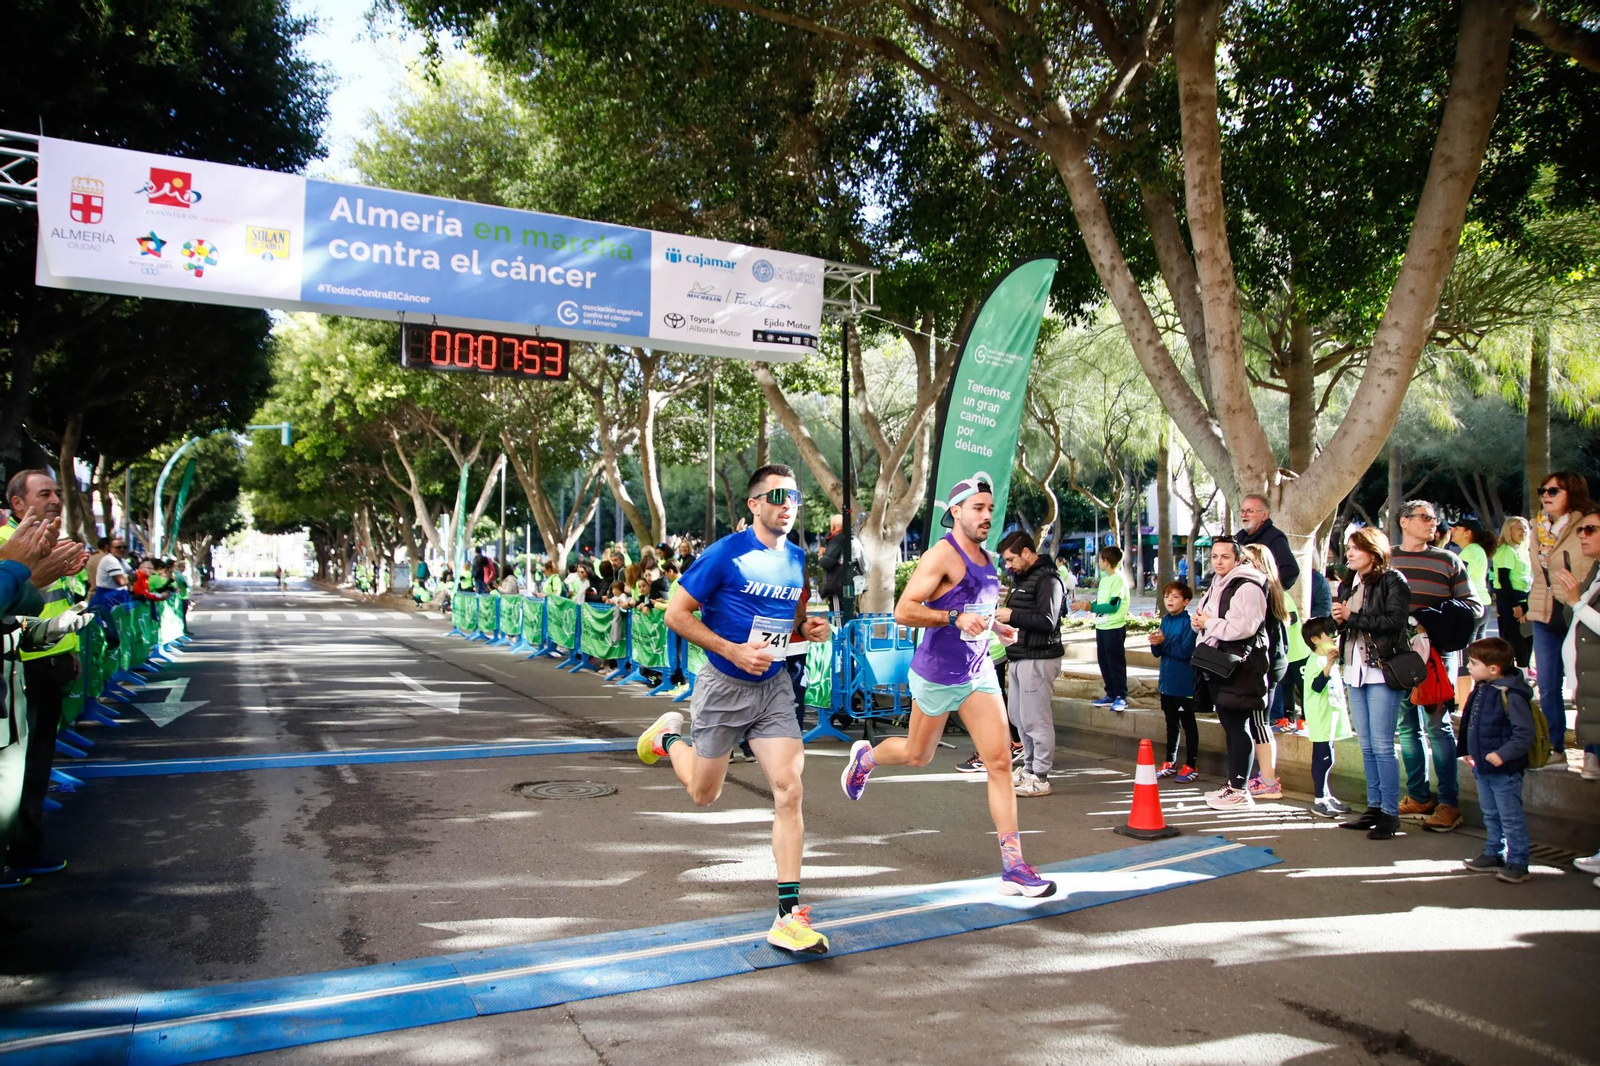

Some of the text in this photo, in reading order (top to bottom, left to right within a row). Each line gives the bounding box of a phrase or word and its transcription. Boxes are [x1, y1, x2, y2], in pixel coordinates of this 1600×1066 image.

[50, 227, 116, 244] ALMERÍA
[251, 229, 285, 244] SOLAN
[329, 196, 634, 262] Almería en marcha
[67, 241, 102, 252] CIUDAD
[328, 238, 597, 290] contra el cáncer
[686, 254, 736, 270] cajamar
[317, 283, 431, 304] #TodosContraElCáncer
[687, 292, 792, 310] MICHELIN Fundación
[582, 304, 615, 312] asociación
[593, 320, 617, 328] Almería
[690, 315, 715, 324] Toyota
[764, 318, 811, 330] Ejido Motor
[689, 324, 742, 337] Alborán Motor
[430, 330, 563, 376] 00:07:53
[968, 379, 1011, 400] Tenemos
[963, 396, 1000, 414] un gran
[960, 410, 996, 428] camino
[956, 425, 974, 437] por
[954, 438, 993, 458] delante
[762, 632, 788, 648] 741
